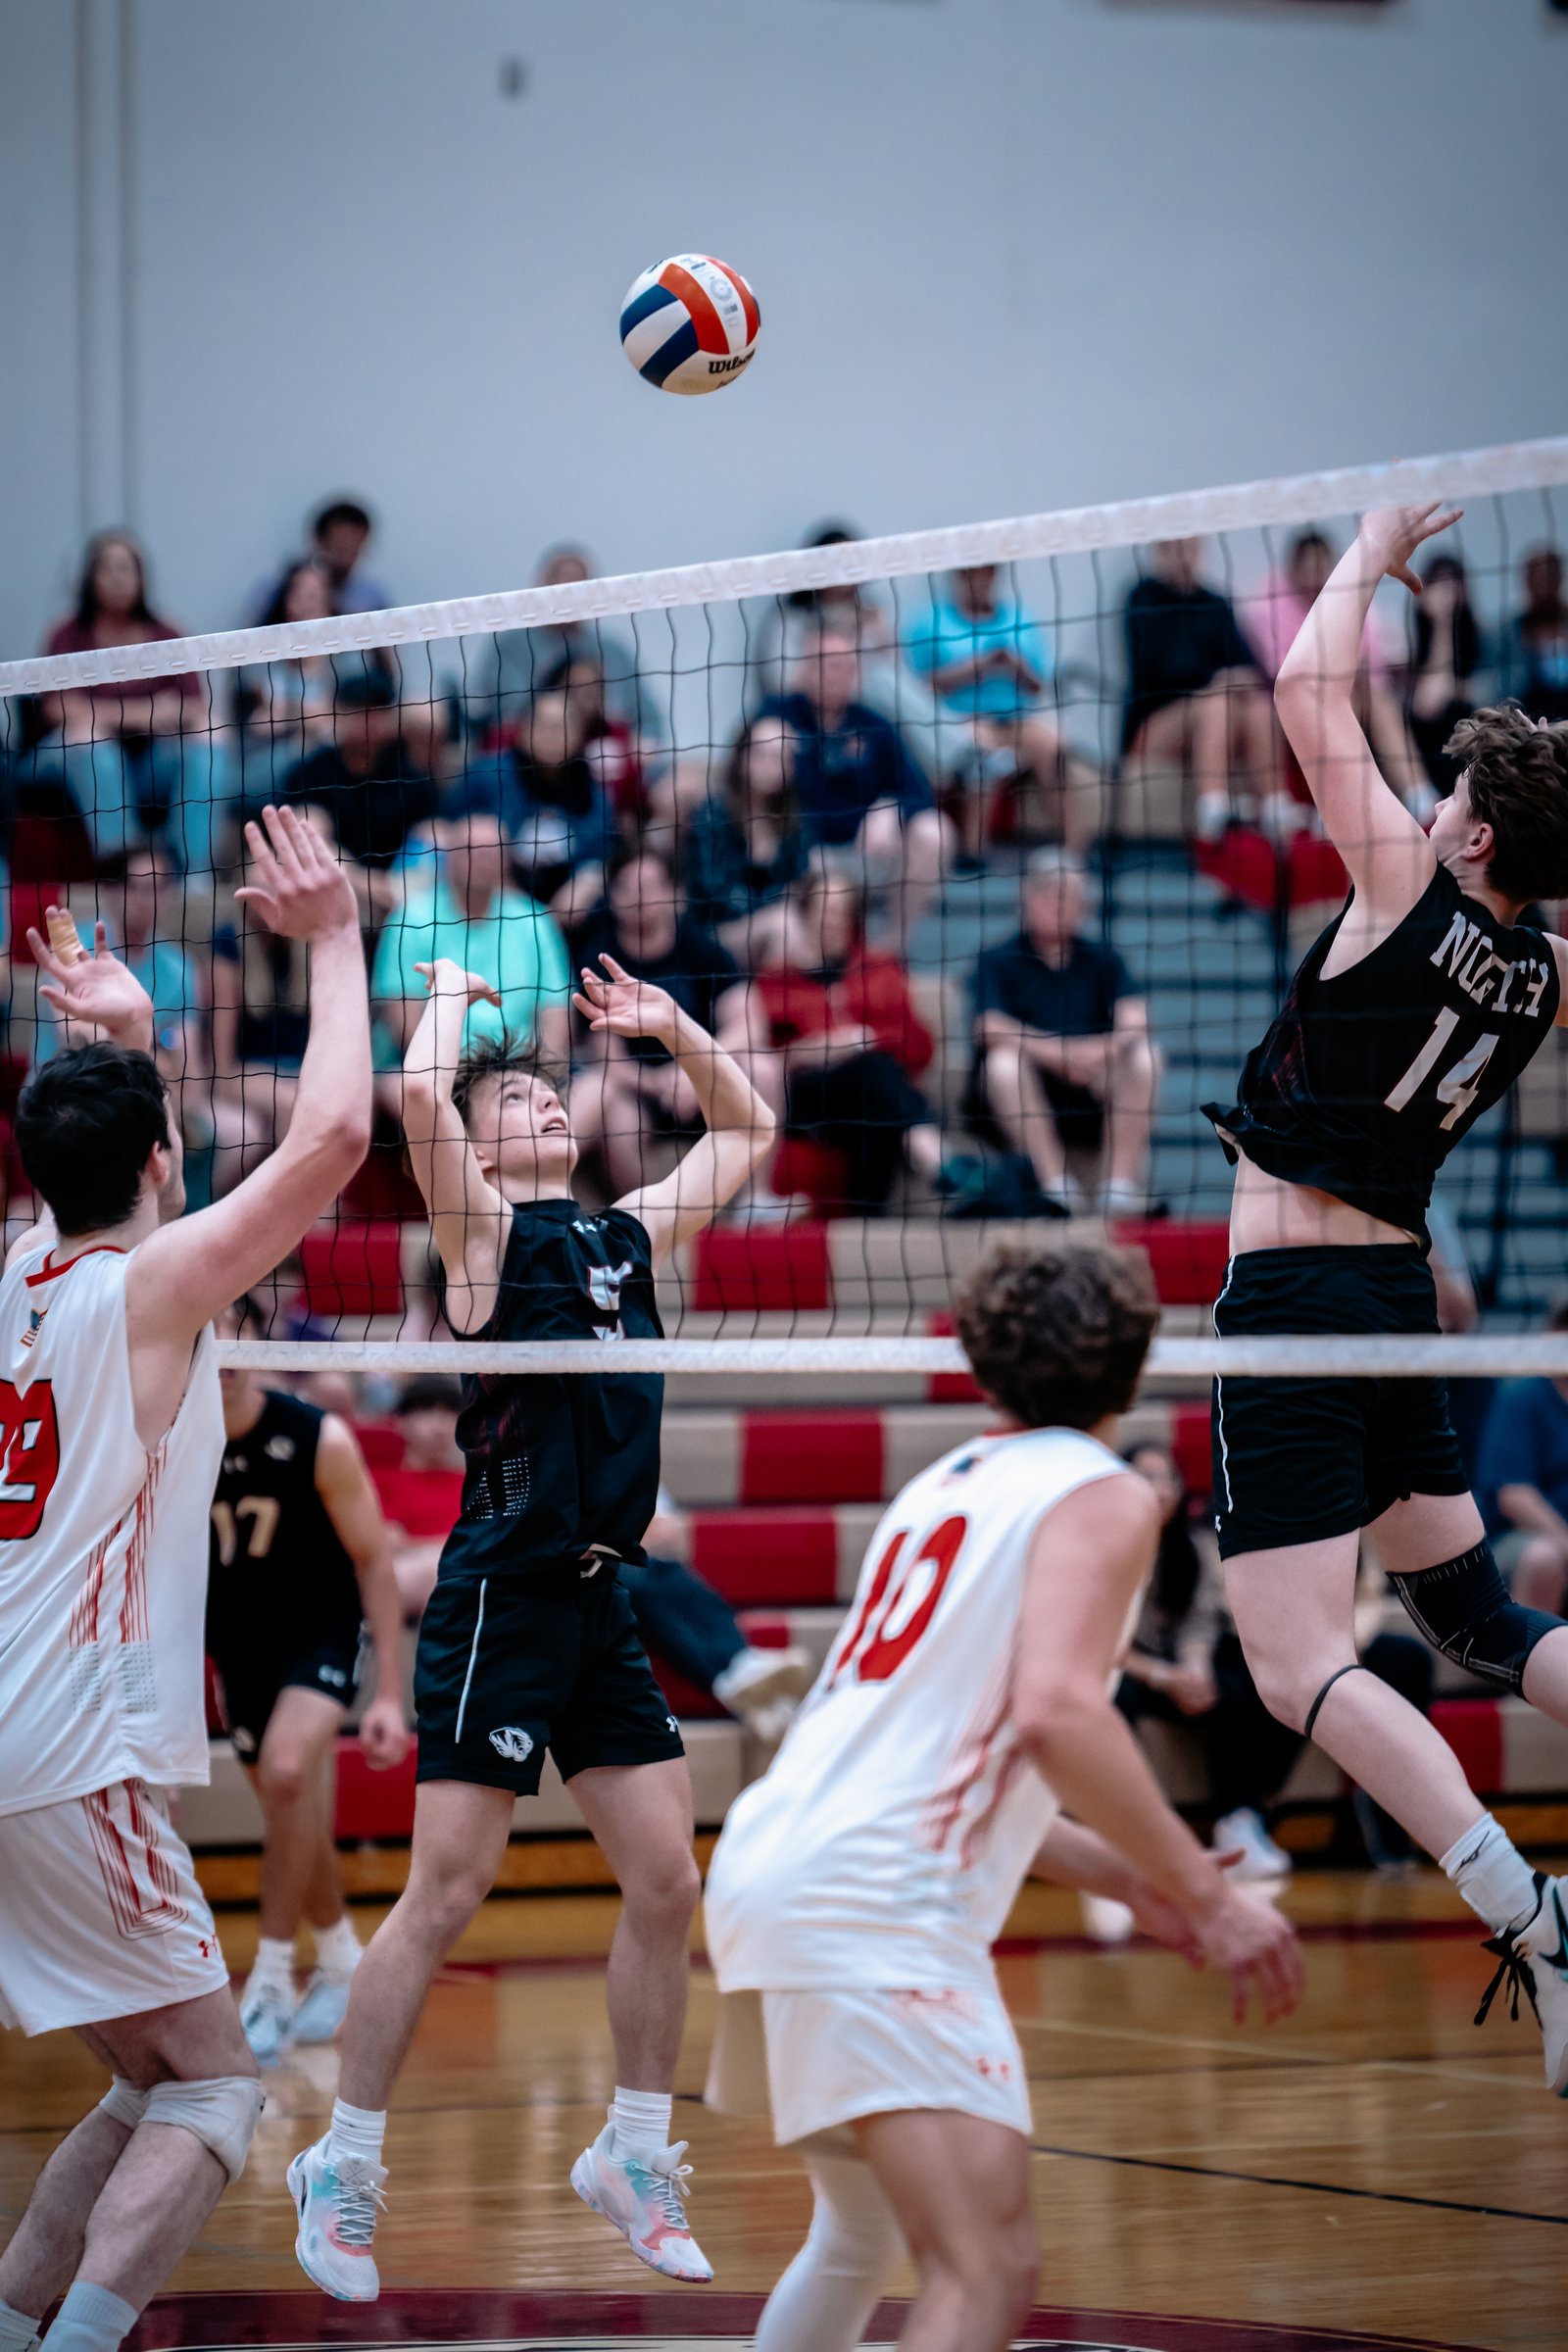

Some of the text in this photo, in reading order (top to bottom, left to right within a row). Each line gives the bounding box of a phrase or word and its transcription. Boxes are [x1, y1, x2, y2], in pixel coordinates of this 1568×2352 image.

[1384, 1005, 1500, 1131] 14
[210, 1495, 280, 1566] 17
[826, 1515, 966, 1691] 10
